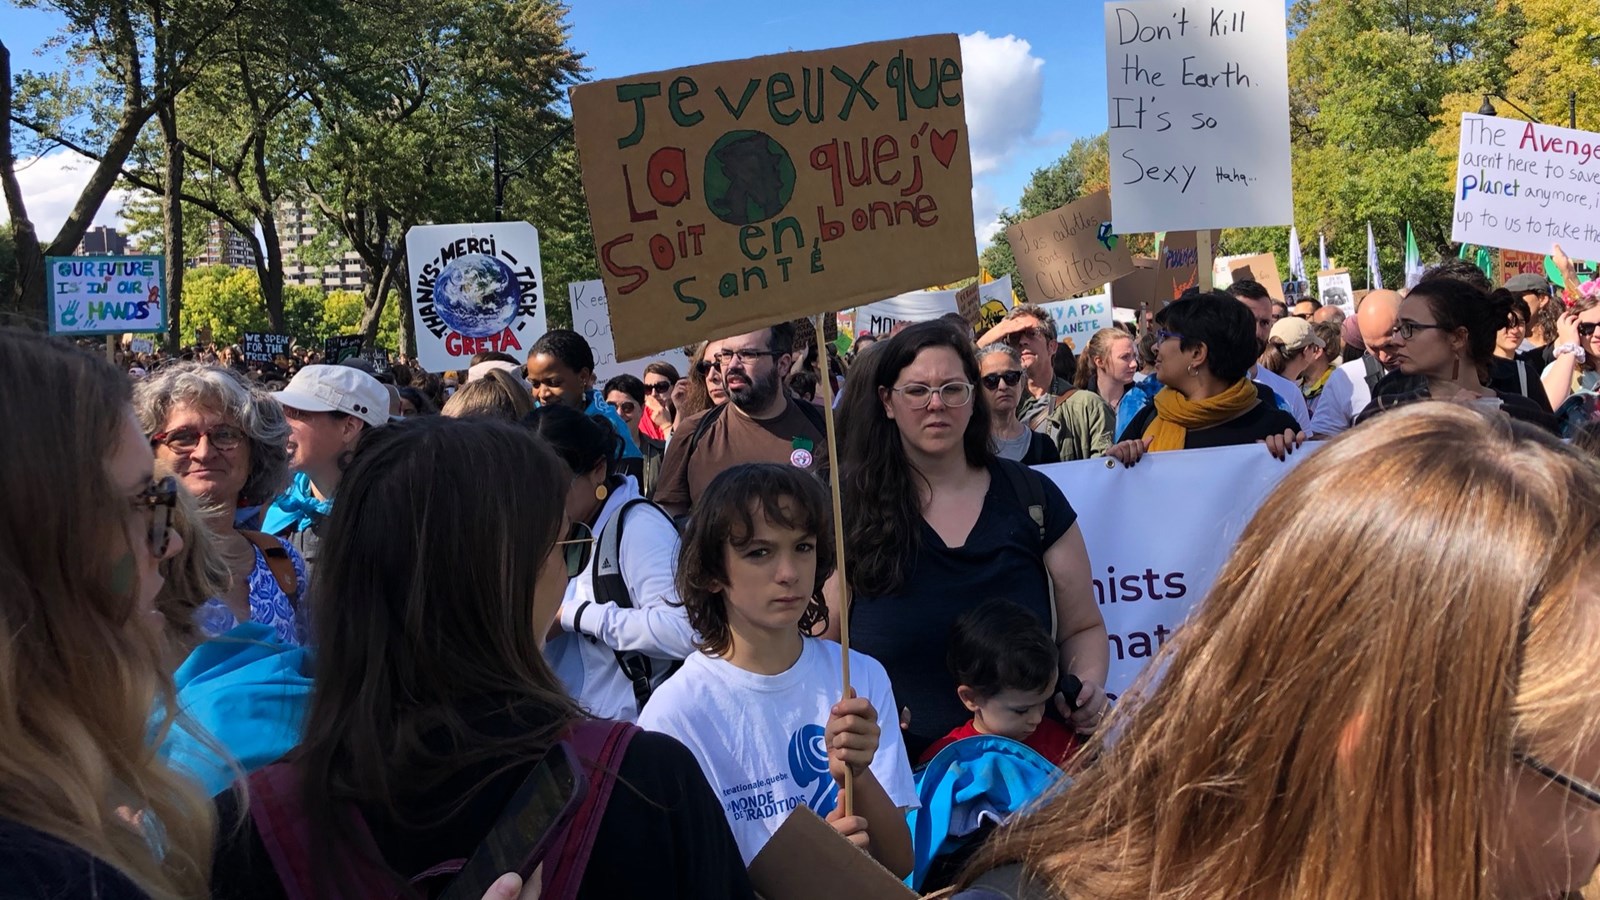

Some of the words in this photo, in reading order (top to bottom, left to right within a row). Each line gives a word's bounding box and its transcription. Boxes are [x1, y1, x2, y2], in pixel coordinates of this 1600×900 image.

[1115, 7, 1189, 46] Don't
[1209, 7, 1245, 37] Kill
[1121, 53, 1166, 87] the
[616, 75, 705, 149] Je
[714, 60, 880, 126] veux
[885, 49, 963, 122] que
[1110, 96, 1172, 132] It's
[1191, 112, 1218, 130] so
[1464, 118, 1506, 147] The
[622, 146, 691, 222] La
[809, 134, 901, 207] que
[1122, 149, 1196, 193] Sexy
[1463, 151, 1503, 170] aren't
[1507, 153, 1538, 175] here
[1544, 160, 1564, 179] to
[738, 216, 805, 261] en
[818, 194, 939, 243] bonne
[1457, 211, 1473, 231] up
[1480, 209, 1498, 228] to
[1505, 216, 1521, 233] us
[1526, 216, 1542, 234] to
[1545, 217, 1579, 240] take
[58, 261, 95, 278] OUR
[97, 261, 154, 278] FUTURE
[86, 281, 108, 294] IN
[117, 281, 143, 294] OUR
[88, 301, 150, 320] HANDS
[1081, 302, 1104, 316] PAS
[244, 333, 260, 342] WE
[264, 334, 290, 344] SPEAK
[246, 342, 263, 352] FOR
[266, 343, 283, 353] THE
[445, 326, 522, 356] GRETA
[246, 352, 273, 361] TREES
[734, 810, 744, 820] DE
